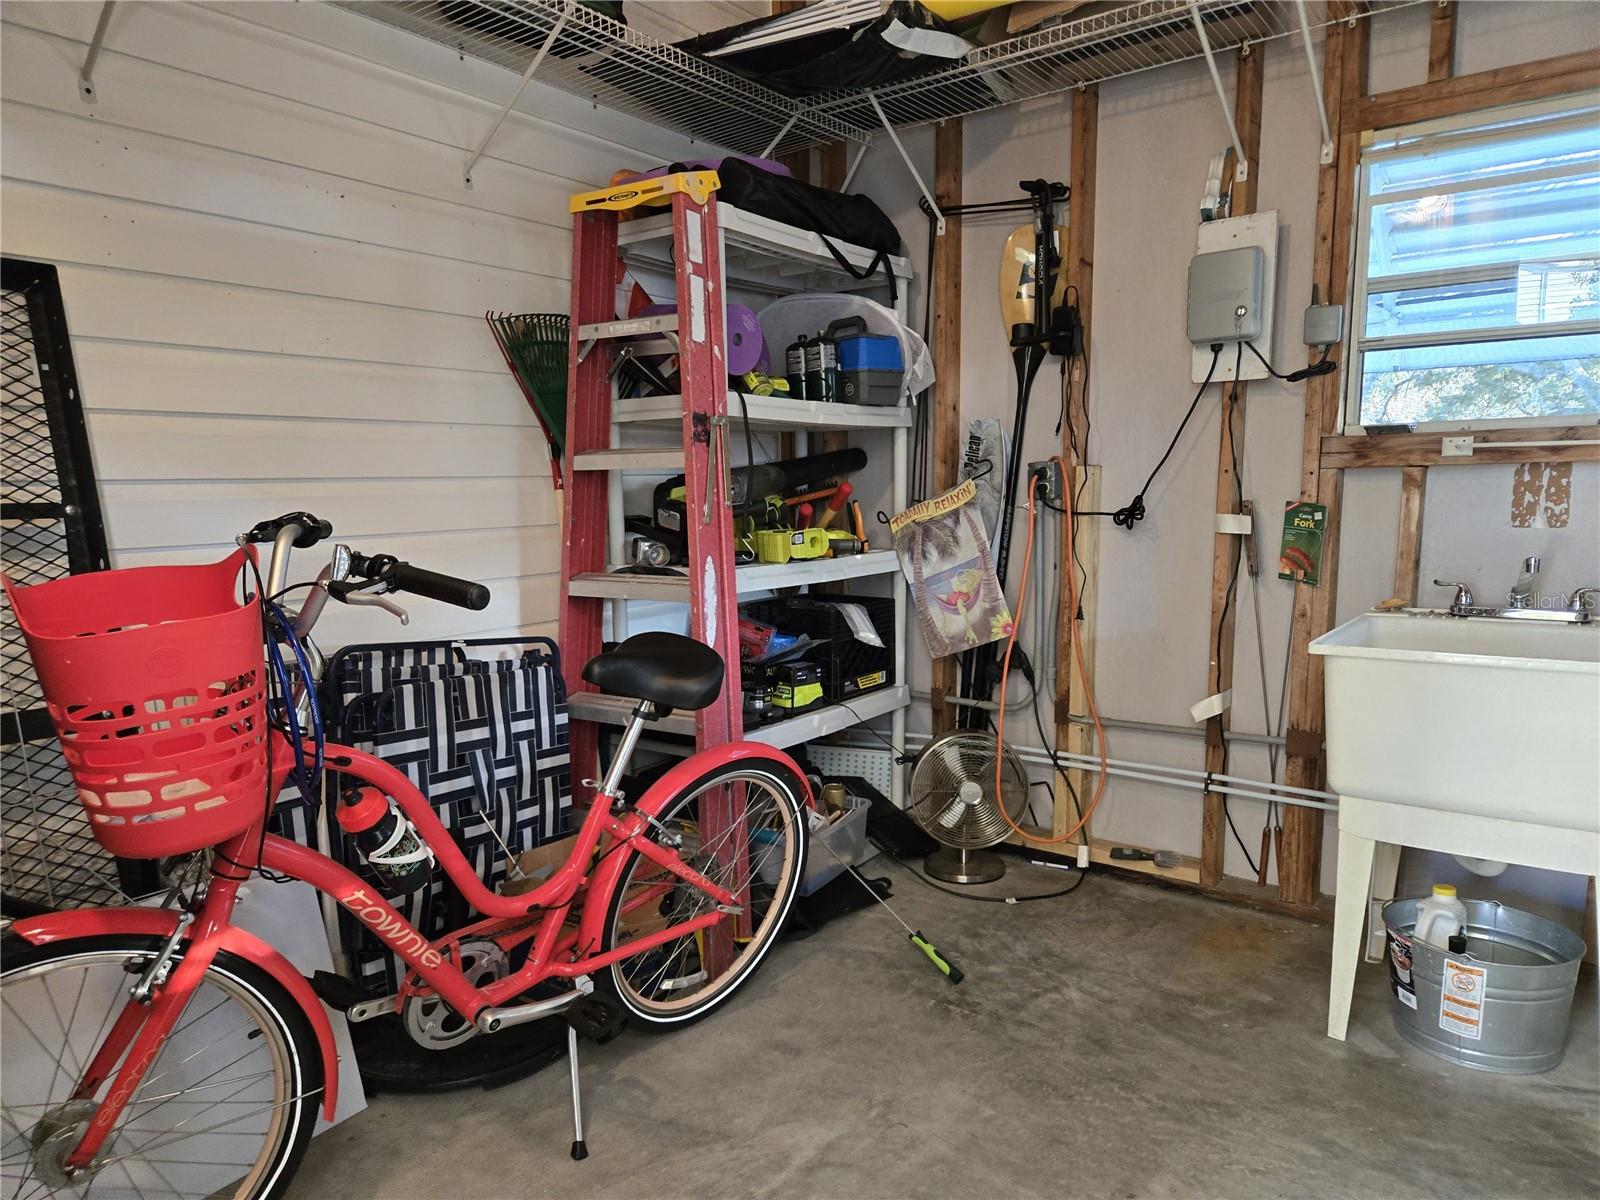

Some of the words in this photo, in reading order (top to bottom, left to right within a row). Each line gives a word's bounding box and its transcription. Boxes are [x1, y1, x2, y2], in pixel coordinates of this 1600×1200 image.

[964, 435, 981, 469] Pelican
[1294, 518, 1315, 528] Fork
[341, 889, 441, 968] townie
